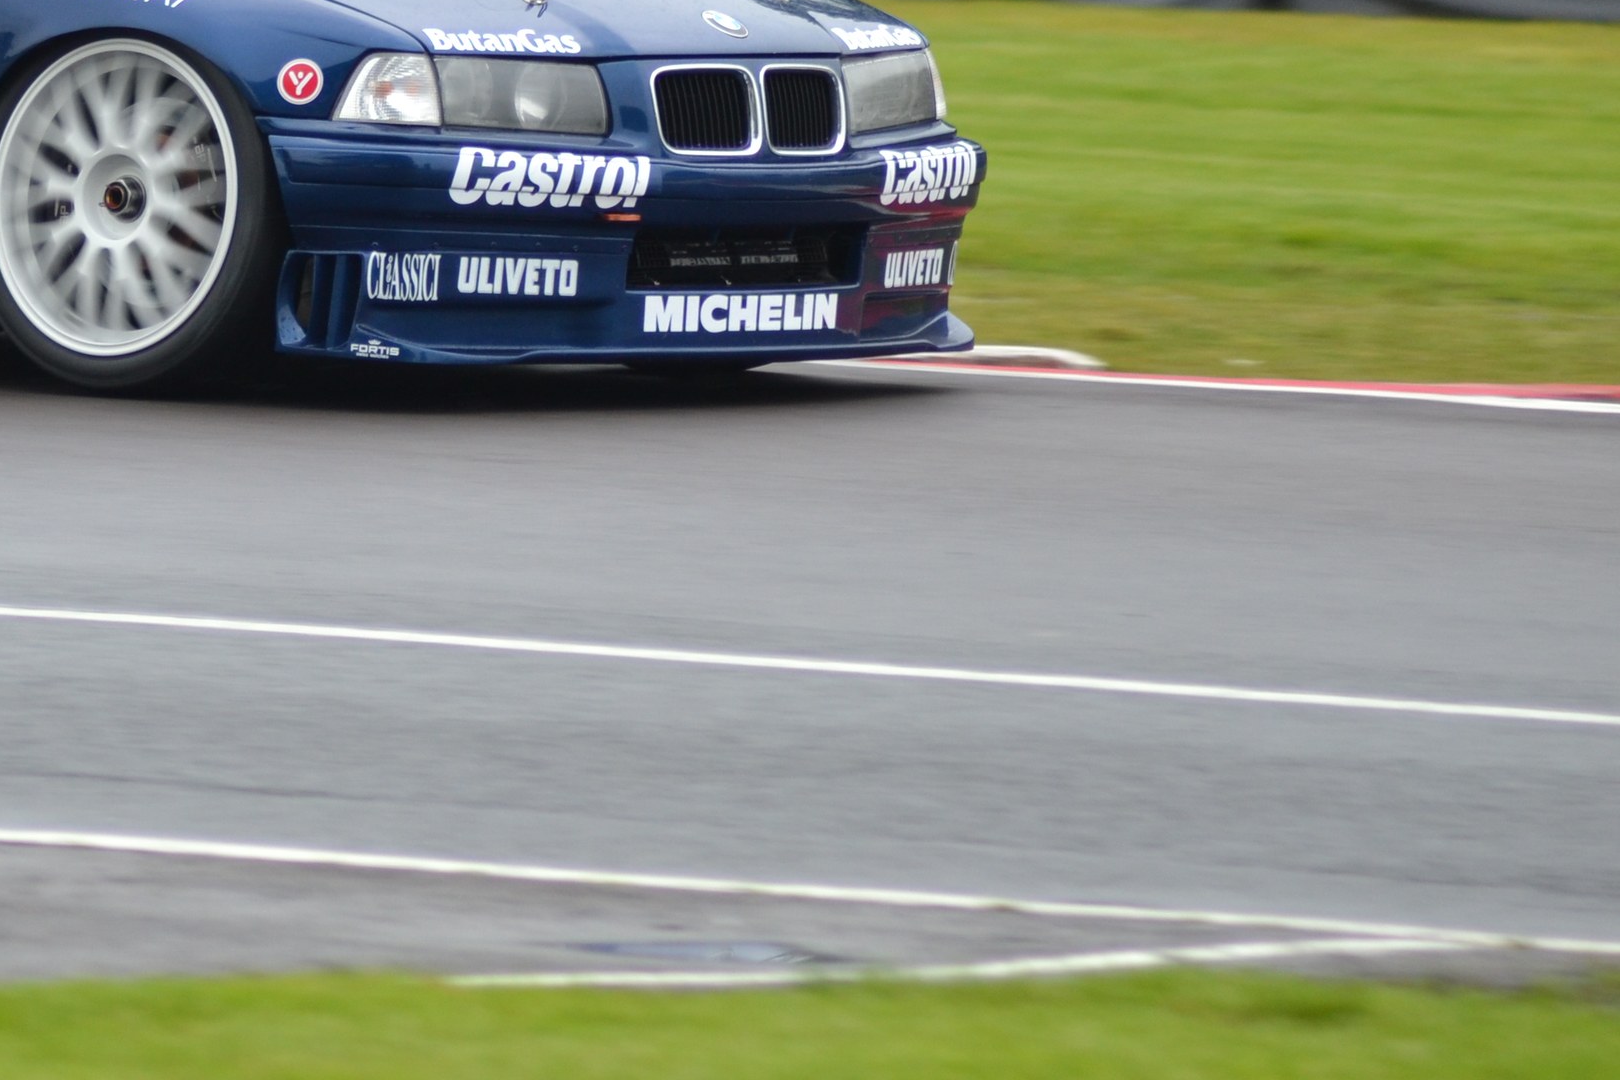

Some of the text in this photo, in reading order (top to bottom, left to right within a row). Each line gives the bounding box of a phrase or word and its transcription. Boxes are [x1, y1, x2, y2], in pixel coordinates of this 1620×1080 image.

[422, 28, 581, 54] ButanGas
[448, 146, 651, 209] Castrol
[879, 141, 977, 206] Castrol
[457, 256, 578, 297] ULIVETO
[884, 248, 944, 288] ULIVETO
[643, 293, 839, 334] MICHELIN
[350, 343, 400, 357] FORTIS
